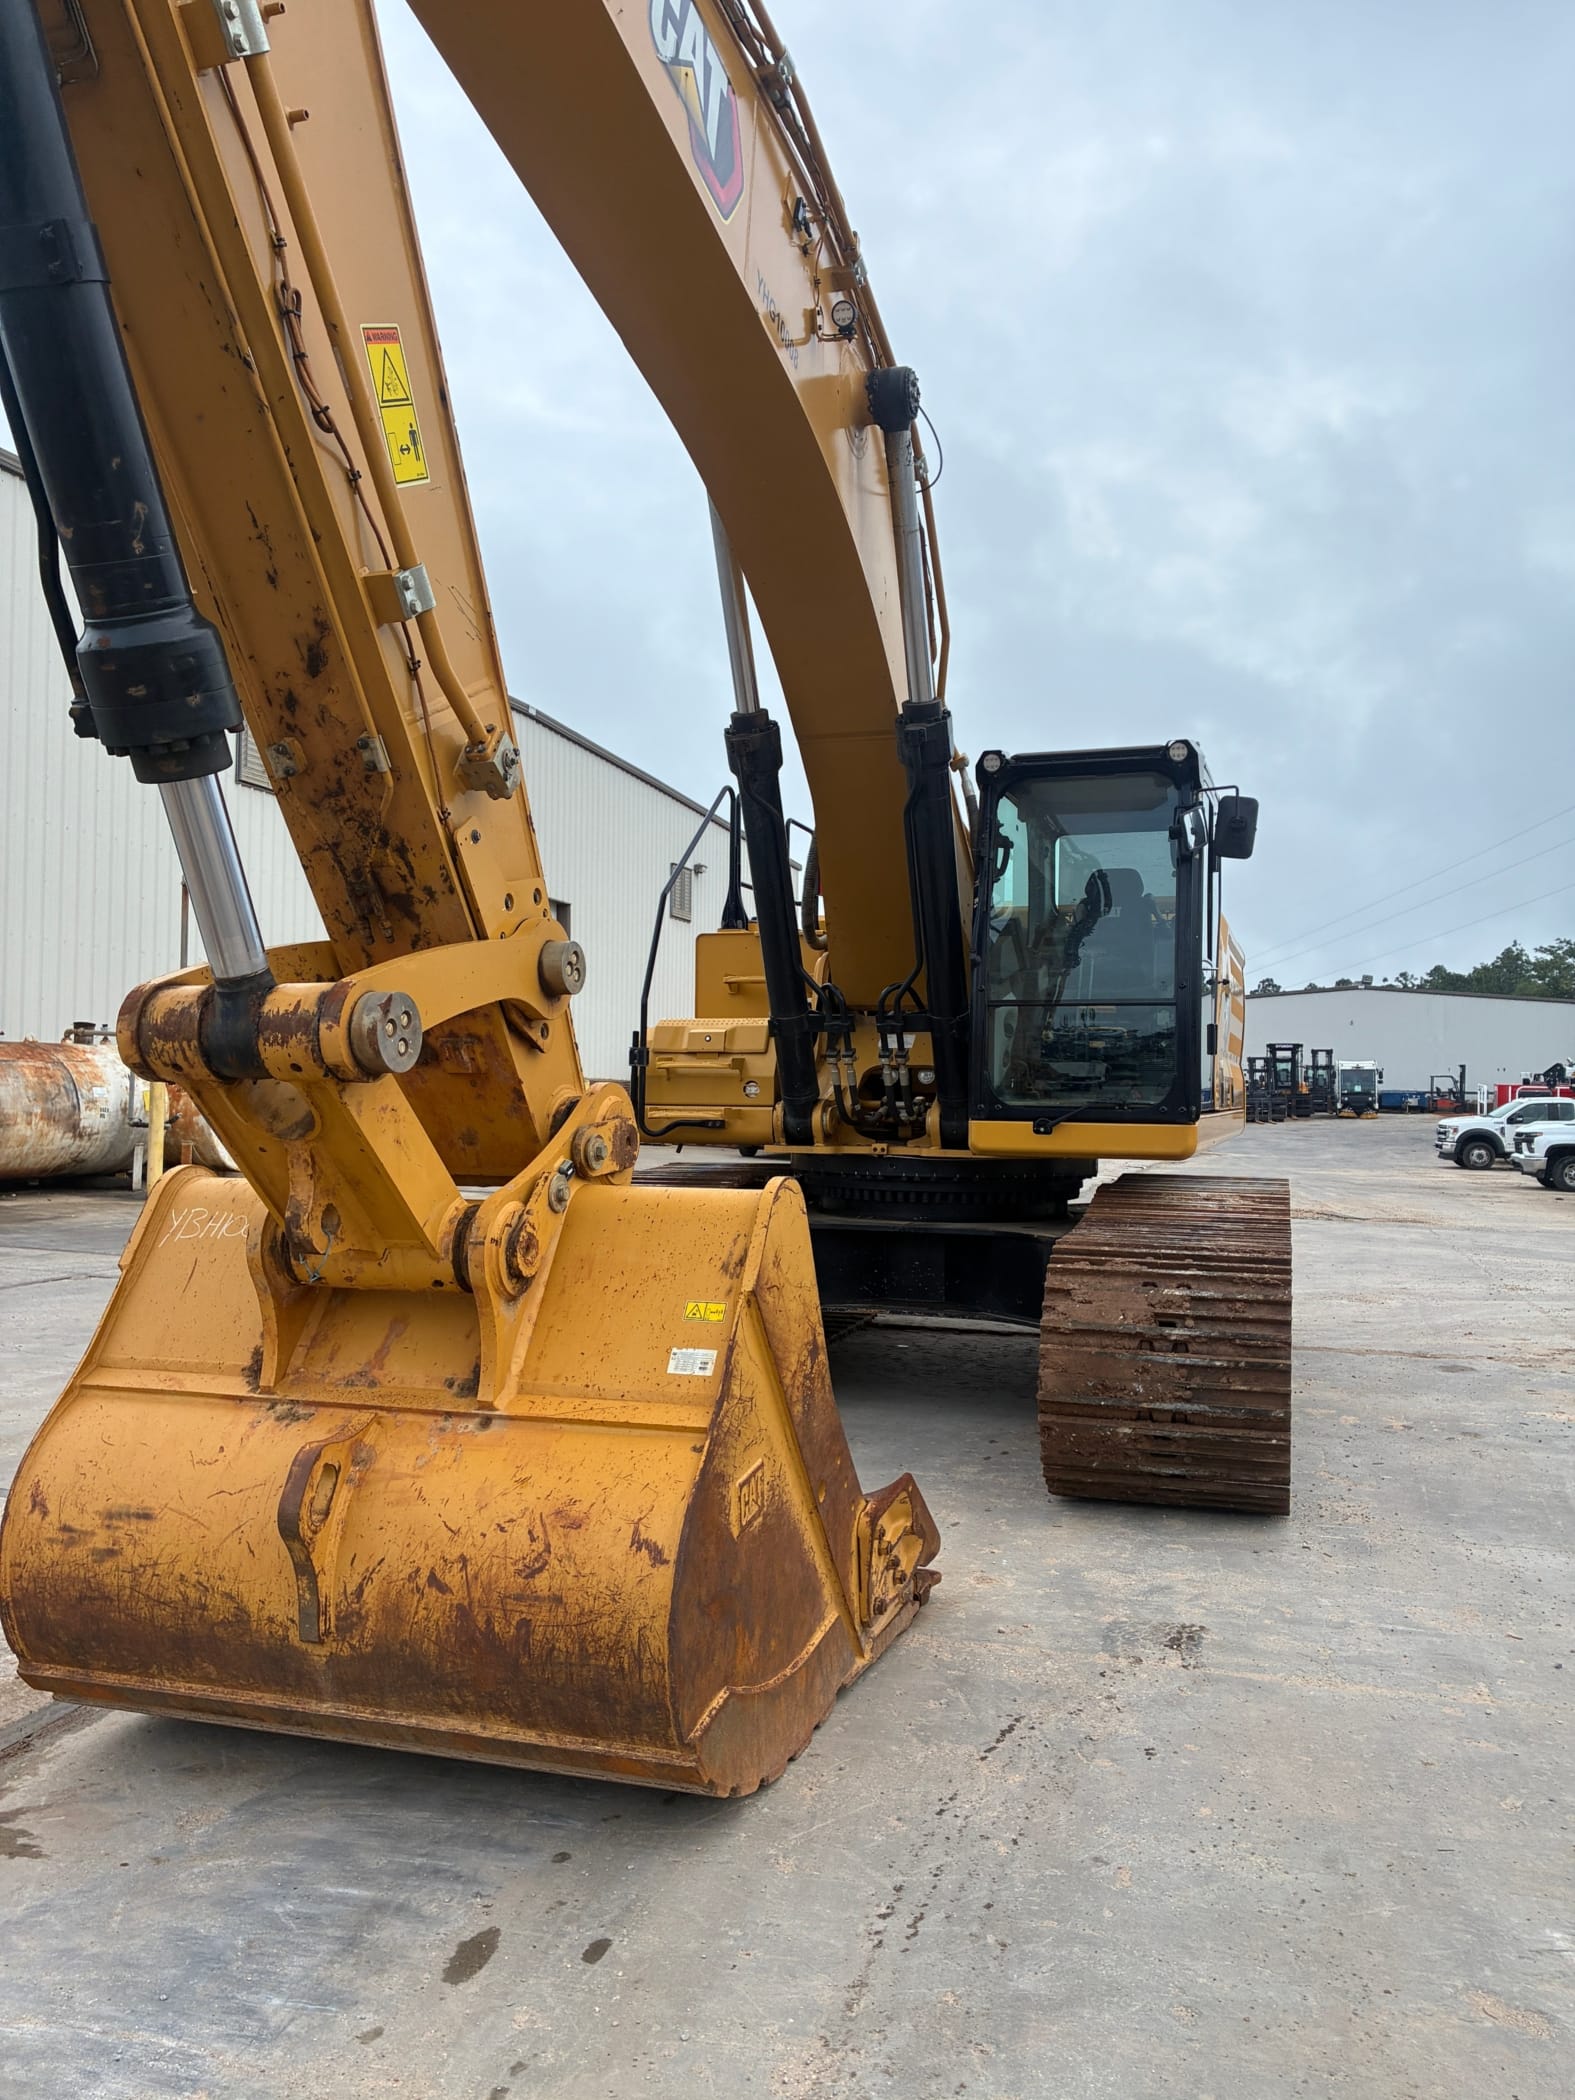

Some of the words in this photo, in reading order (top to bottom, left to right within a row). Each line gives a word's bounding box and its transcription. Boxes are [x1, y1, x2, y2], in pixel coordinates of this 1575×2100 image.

[652, 0, 729, 160] CAT
[372, 332, 398, 341] WARNING
[741, 1470, 764, 1526] CAT
